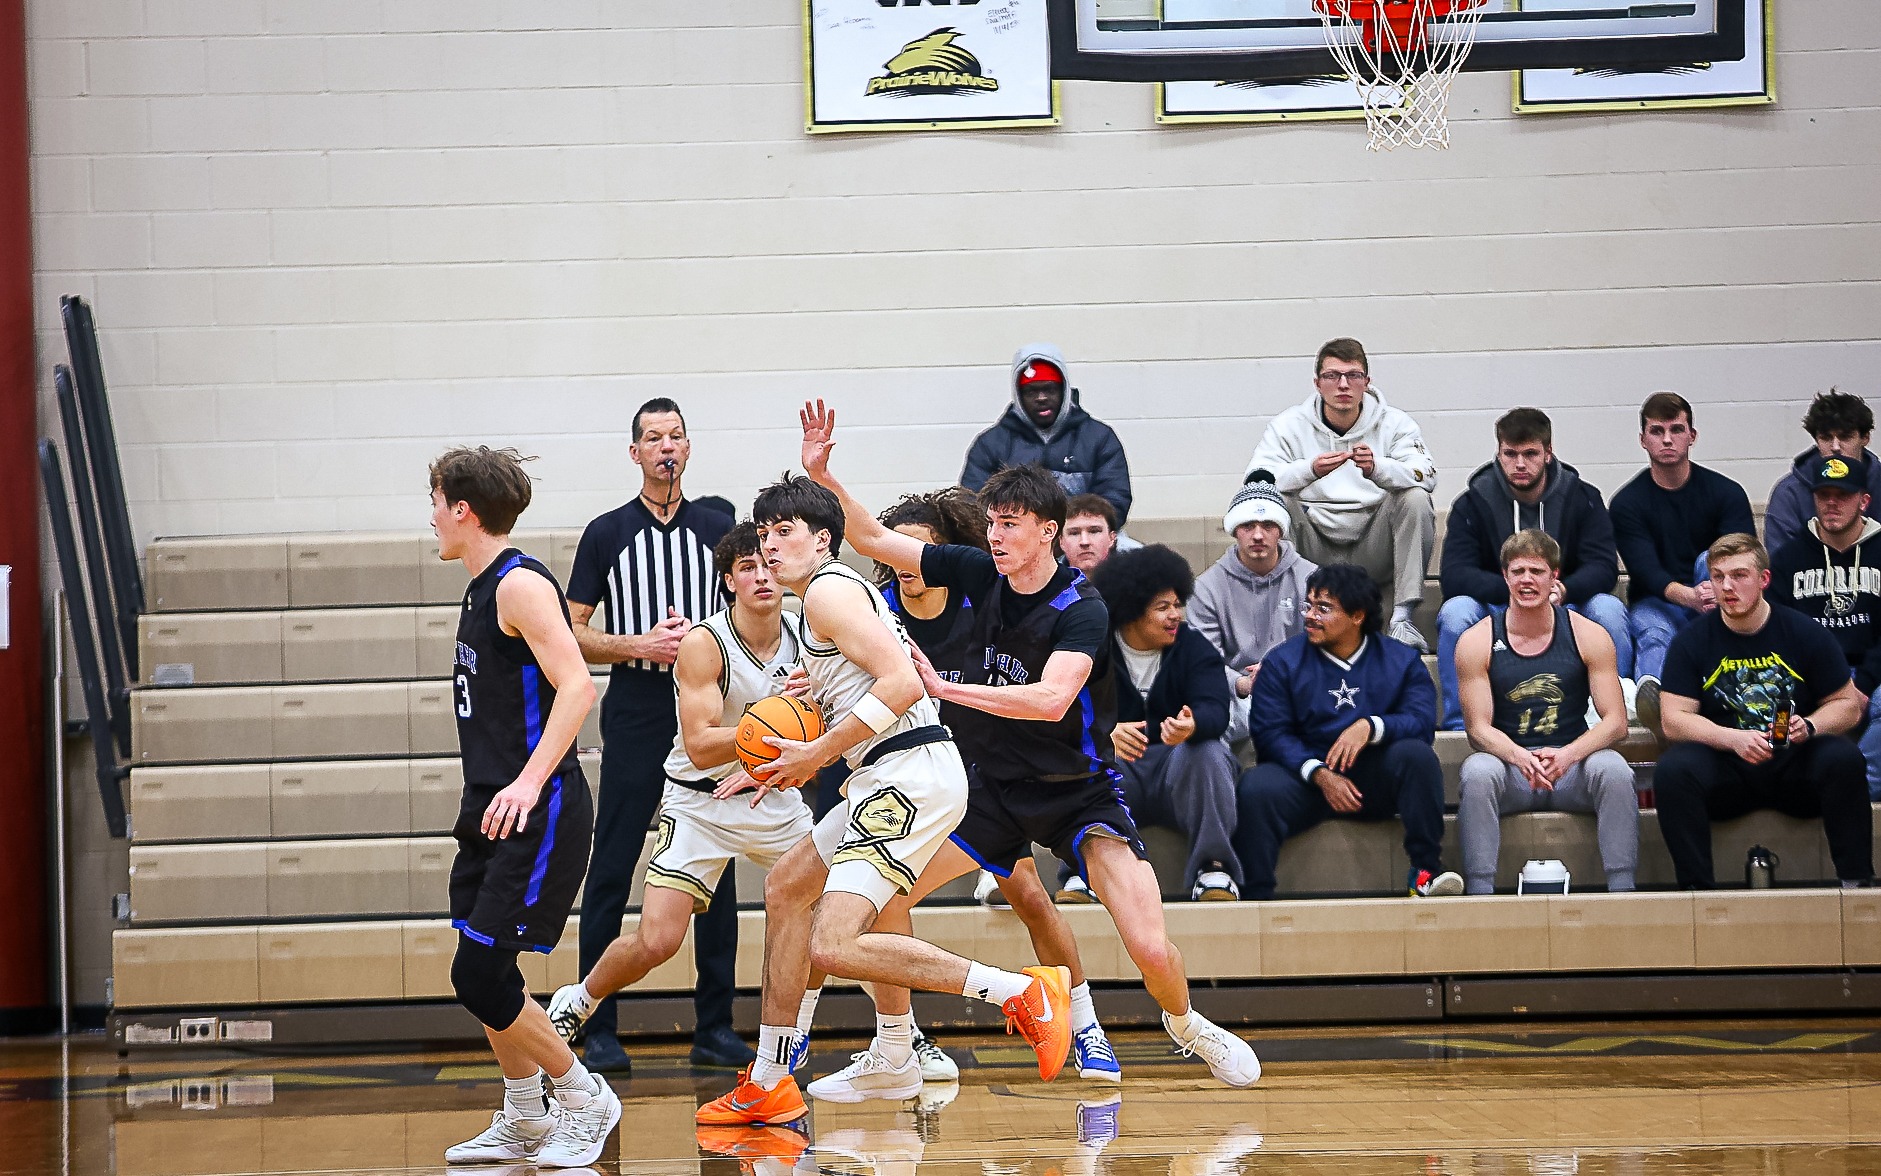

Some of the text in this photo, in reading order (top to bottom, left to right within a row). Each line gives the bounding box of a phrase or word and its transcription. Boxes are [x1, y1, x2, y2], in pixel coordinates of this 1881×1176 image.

[867, 71, 997, 94] PrairieWolves
[1793, 566, 1881, 599] COLORADO
[1702, 652, 1804, 691] METALLICA
[457, 674, 472, 717] 3
[1517, 705, 1559, 735] 14
